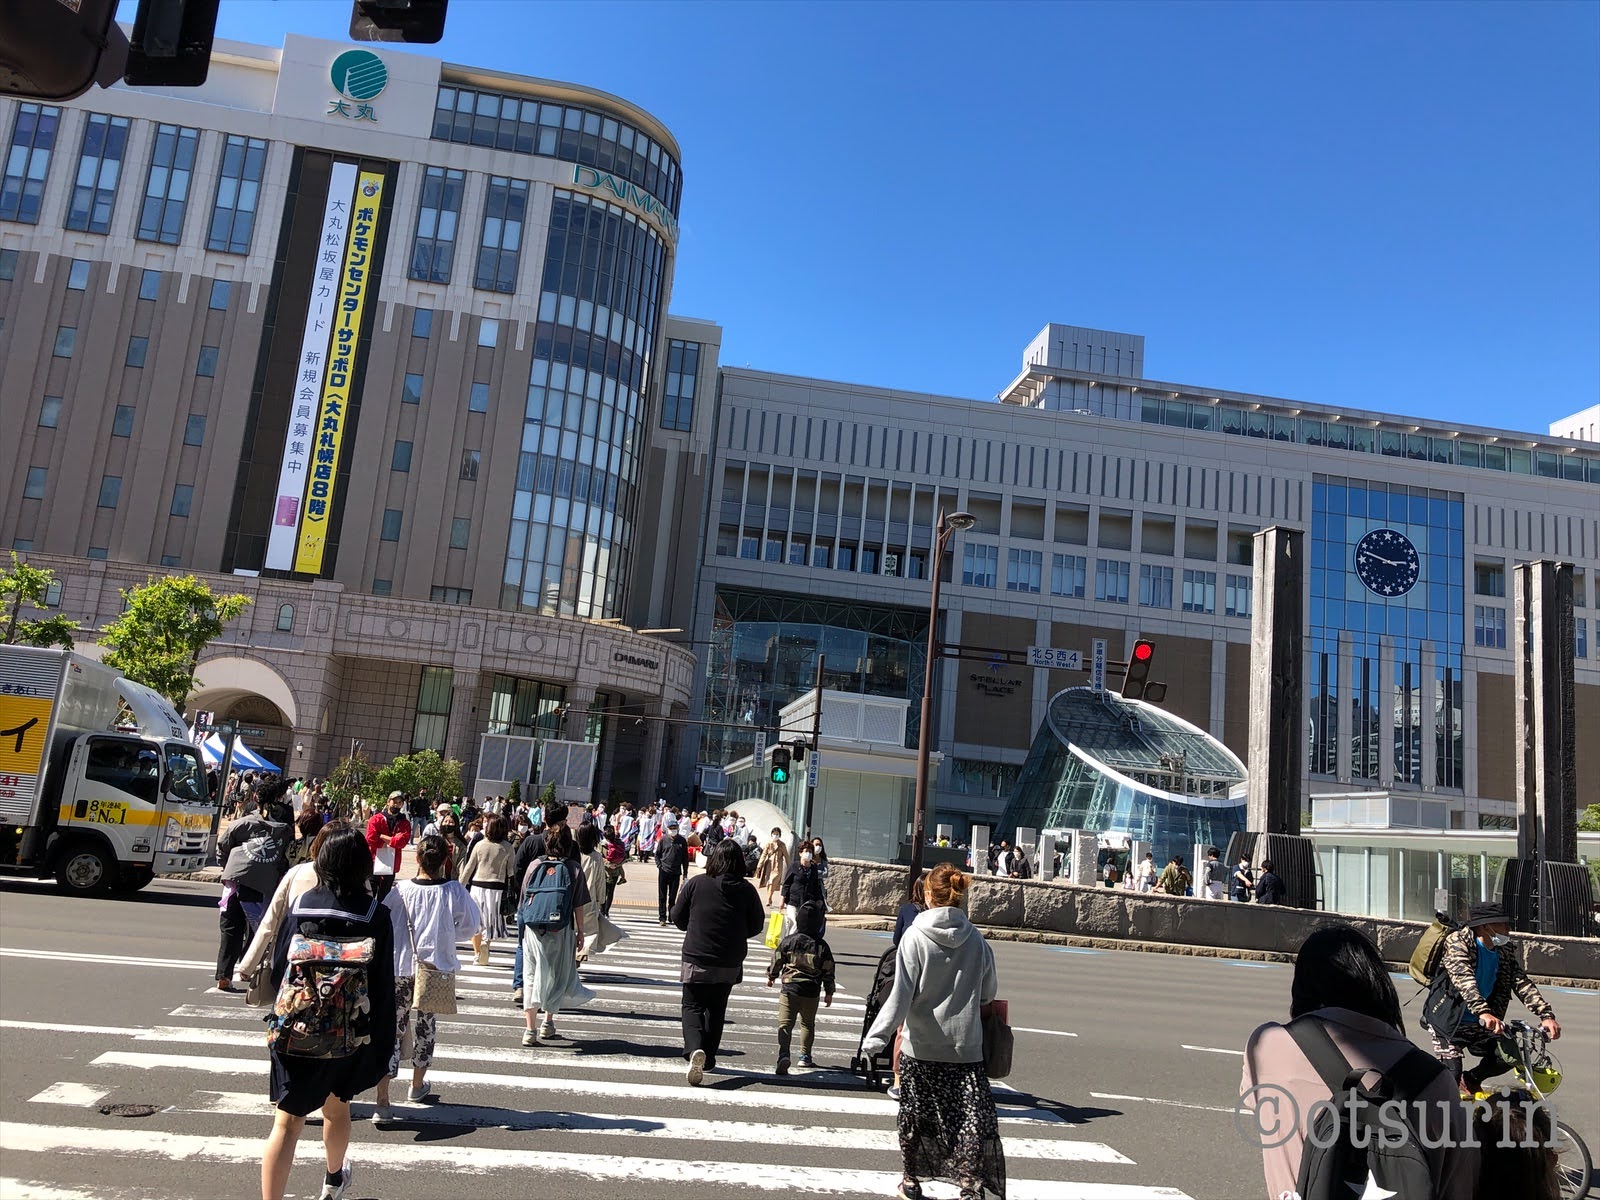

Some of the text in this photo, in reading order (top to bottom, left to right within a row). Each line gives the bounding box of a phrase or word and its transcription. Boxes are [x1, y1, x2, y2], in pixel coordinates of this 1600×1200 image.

[327, 99, 378, 122] 大丸
[573, 164, 679, 243] DAIMAR
[314, 200, 346, 332] 大丸松坂屋カード
[287, 351, 321, 474] 新規会員募集中
[614, 653, 659, 670] DAIMARU
[1032, 648, 1078, 663] 北5西4
[969, 673, 1023, 687] STELLAR
[977, 682, 1015, 694] PLACE
[809, 753, 818, 786] 歩車分離式
